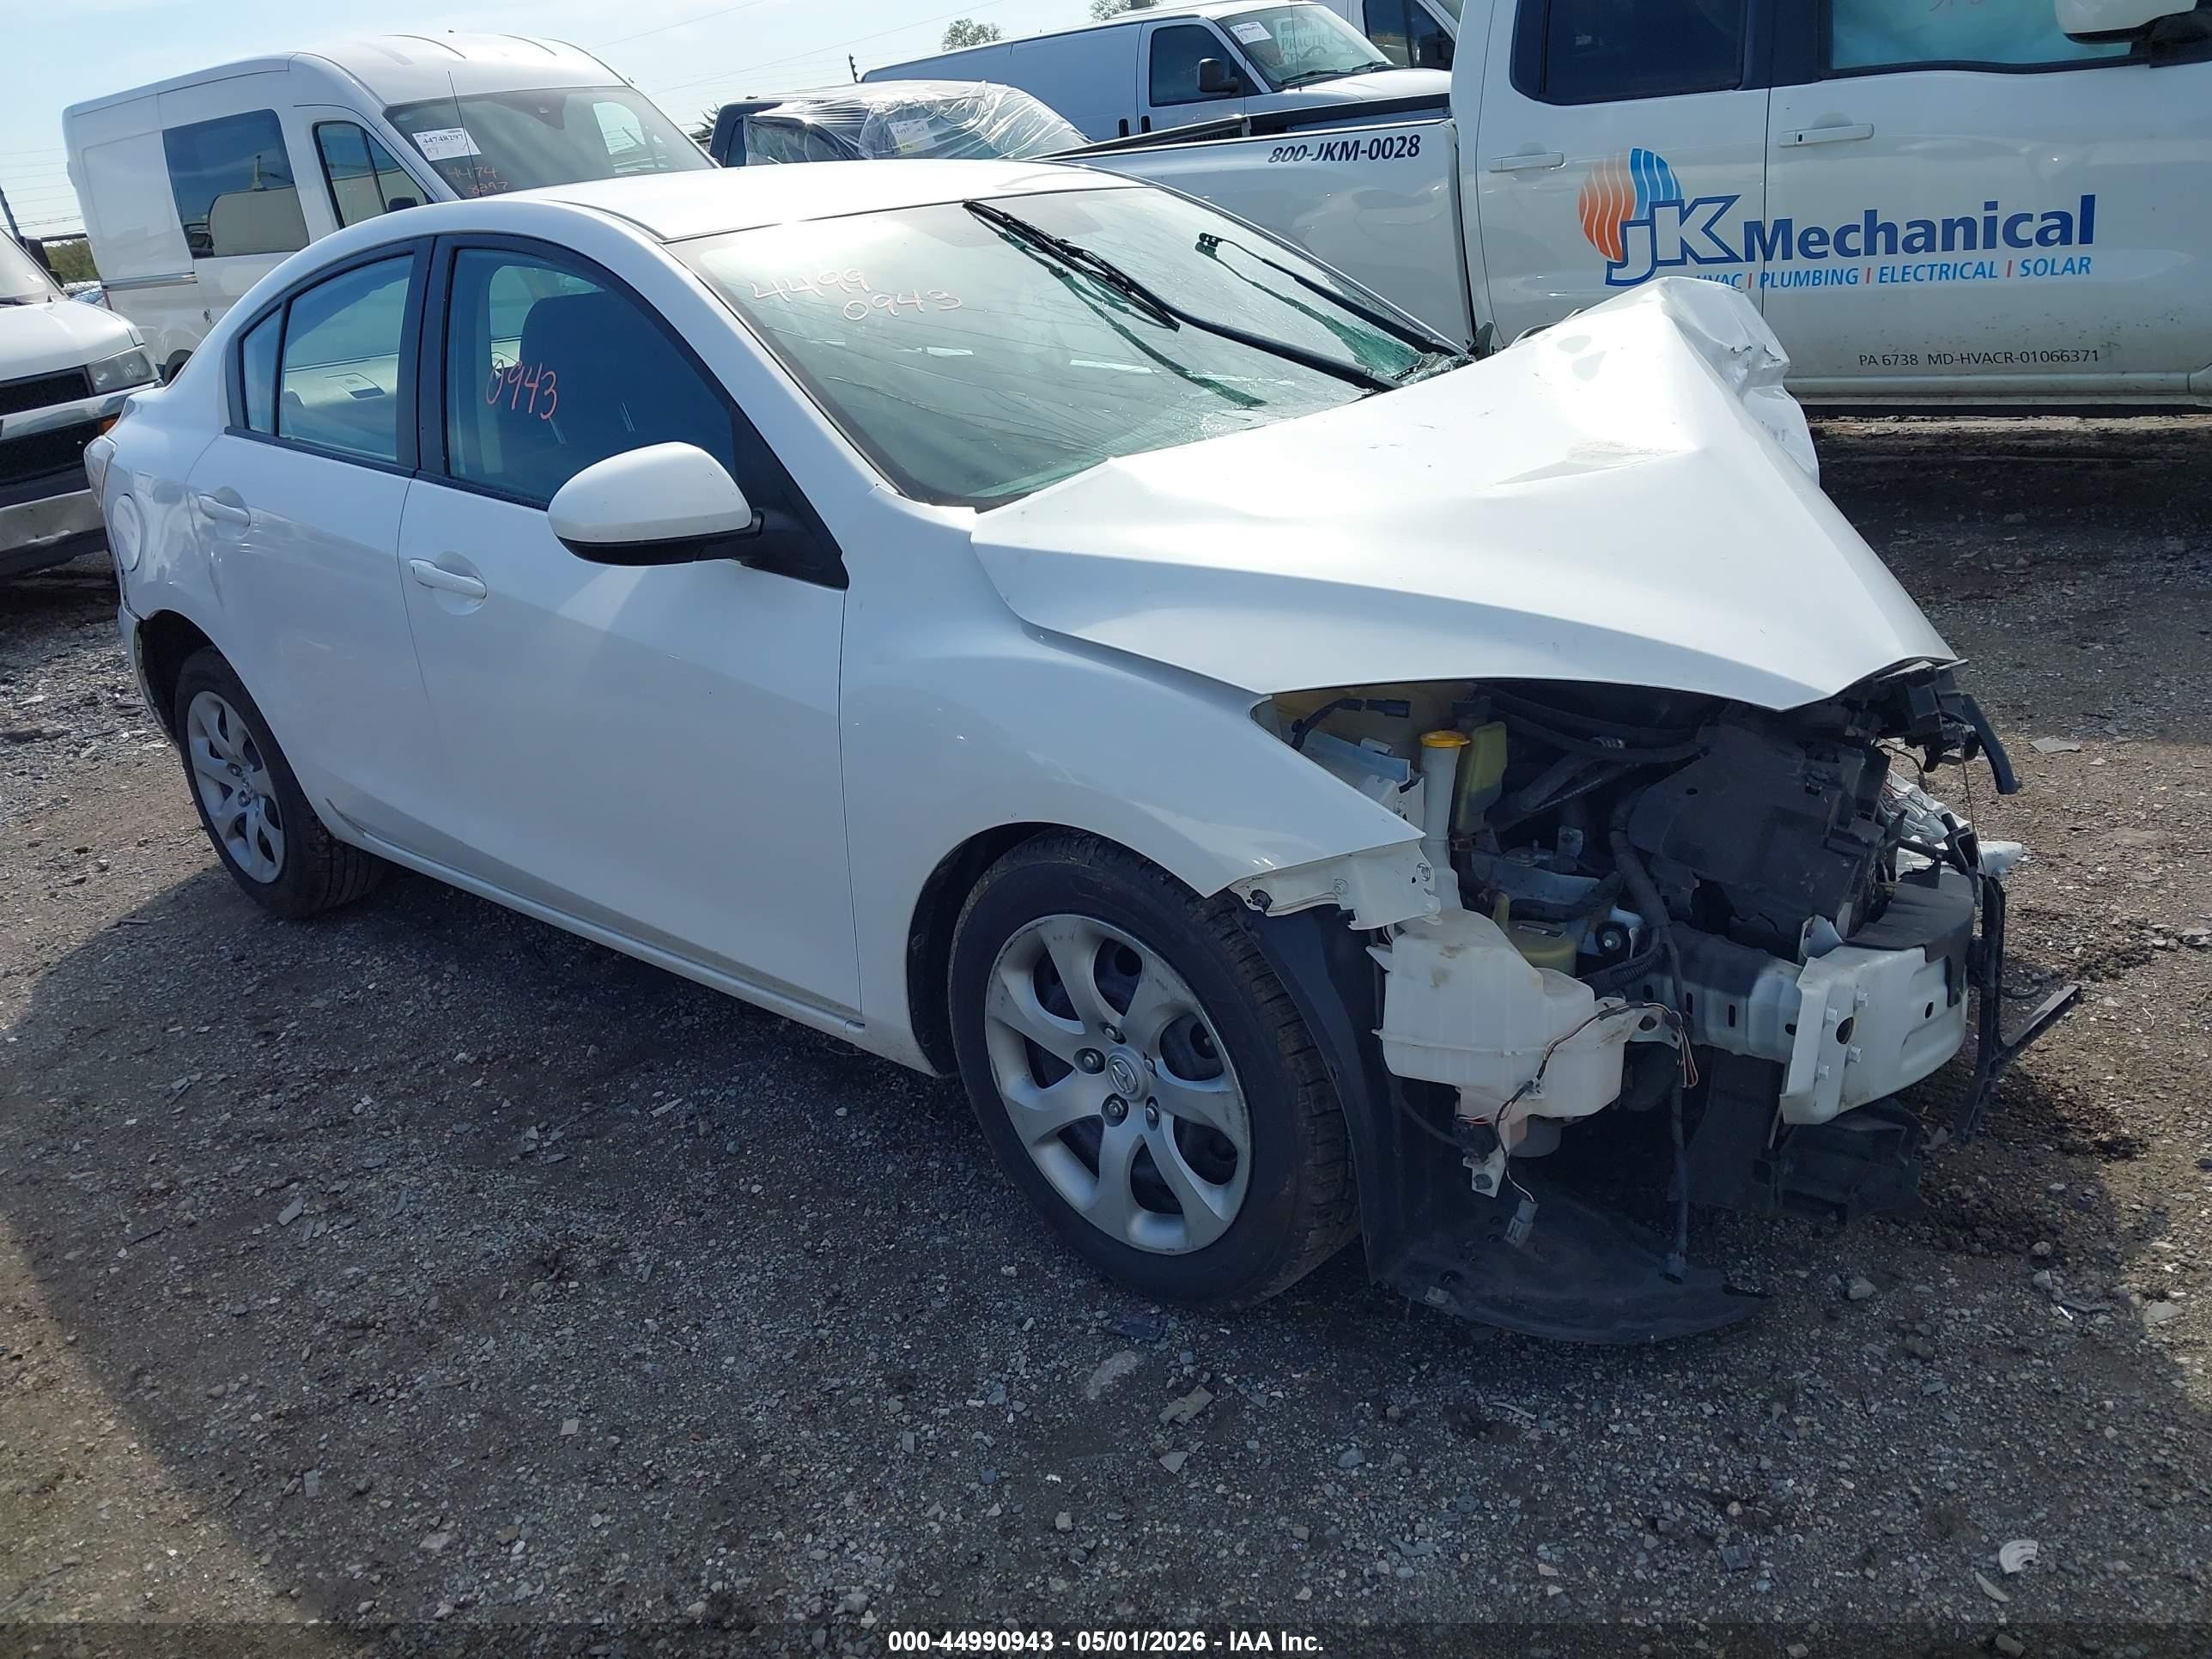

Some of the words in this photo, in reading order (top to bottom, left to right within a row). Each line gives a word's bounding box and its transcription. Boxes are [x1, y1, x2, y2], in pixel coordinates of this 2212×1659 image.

[1267, 134, 1421, 163] 800-JKM-0028
[446, 165, 498, 179] 4474
[1744, 194, 2096, 263] Mechanical
[750, 268, 871, 303] 4499
[1697, 273, 1742, 289] AC
[1759, 267, 1859, 289] PLUMBING
[1878, 261, 1999, 283] ELECTRICAL
[2020, 257, 2093, 277] SOLAR
[843, 289, 962, 321] 0943
[1859, 354, 1879, 367] PA
[1882, 354, 1919, 367] 6738
[1927, 349, 2099, 366] MD-HVACR-01066371
[486, 359, 557, 420] 0943
